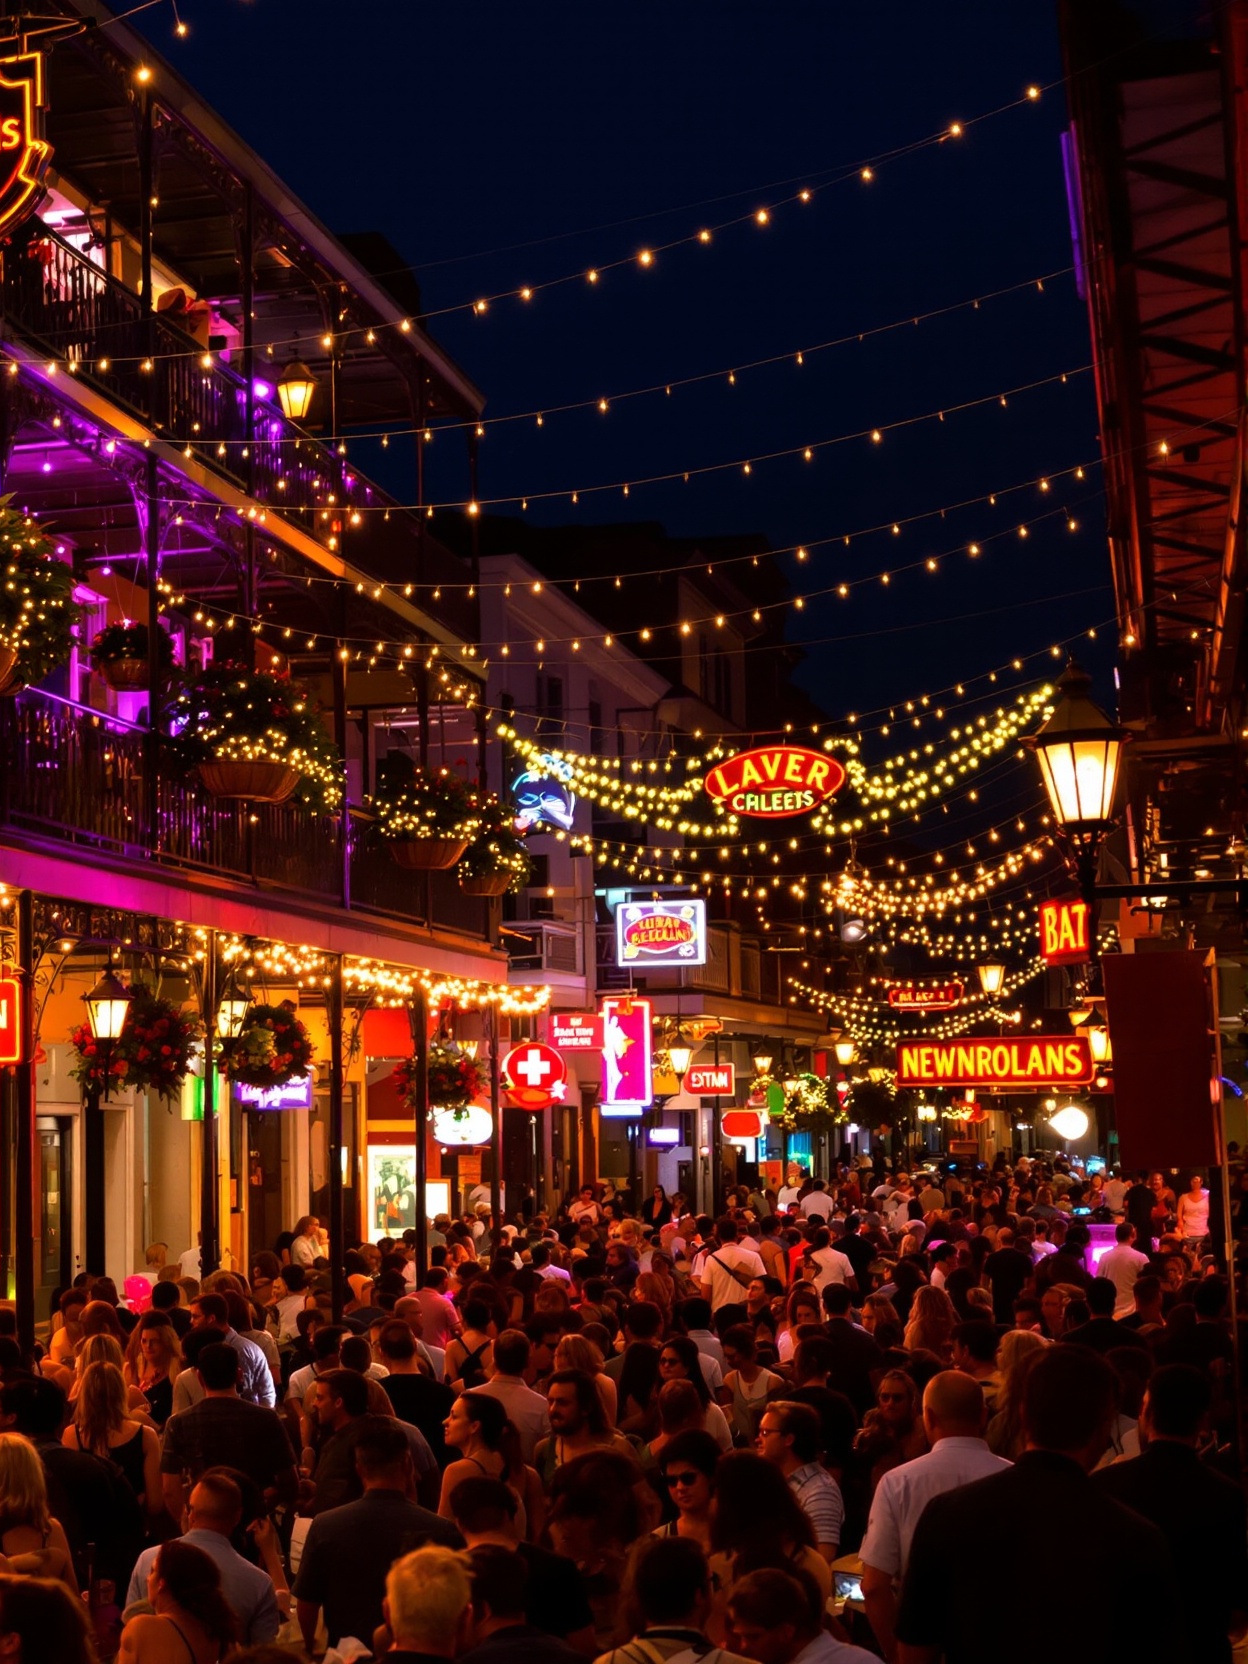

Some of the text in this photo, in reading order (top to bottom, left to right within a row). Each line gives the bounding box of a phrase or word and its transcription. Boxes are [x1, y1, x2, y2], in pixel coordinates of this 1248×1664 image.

[714, 753, 830, 796] LAVER
[1043, 903, 1087, 954] BAT
[901, 1043, 1083, 1079] NEWNROLANS
